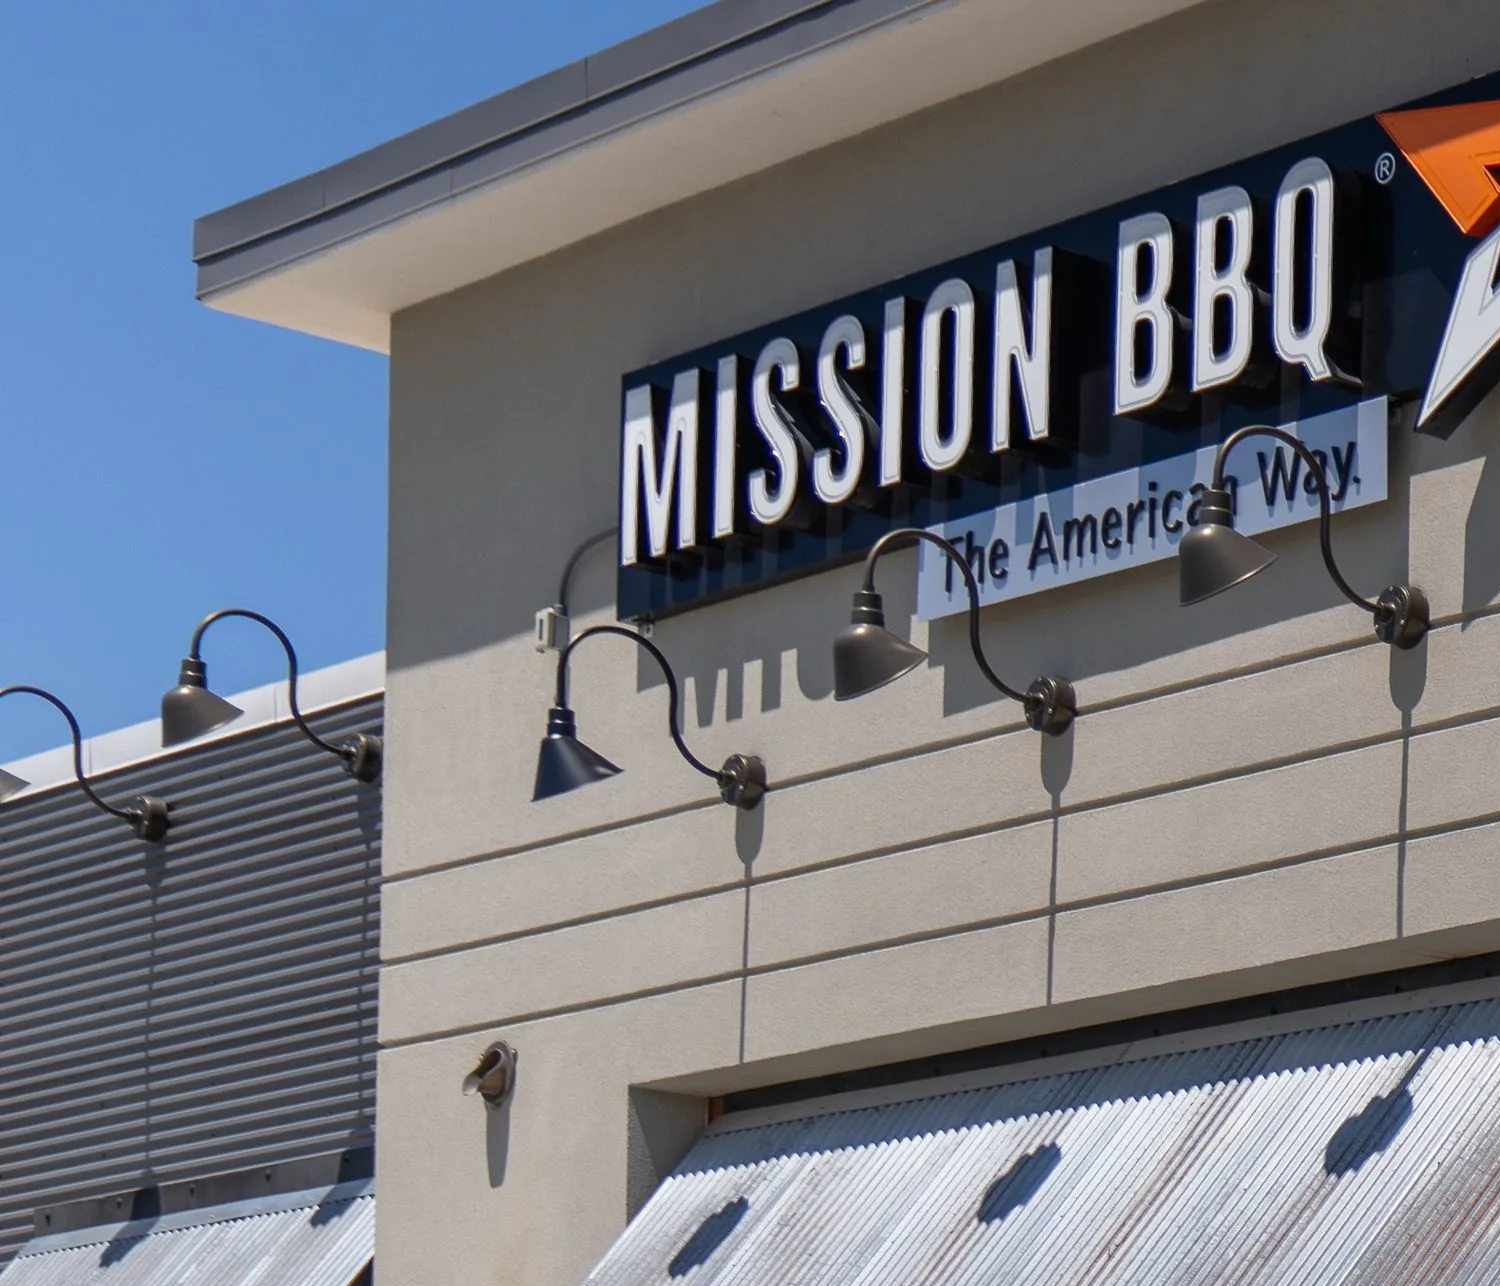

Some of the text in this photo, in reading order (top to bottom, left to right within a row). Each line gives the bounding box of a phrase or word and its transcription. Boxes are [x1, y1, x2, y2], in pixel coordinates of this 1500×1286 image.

[621, 246, 1053, 567] MISSION
[1113, 156, 1334, 416] BBQ
[945, 530, 1009, 594] The
[1256, 441, 1362, 507] Way.
